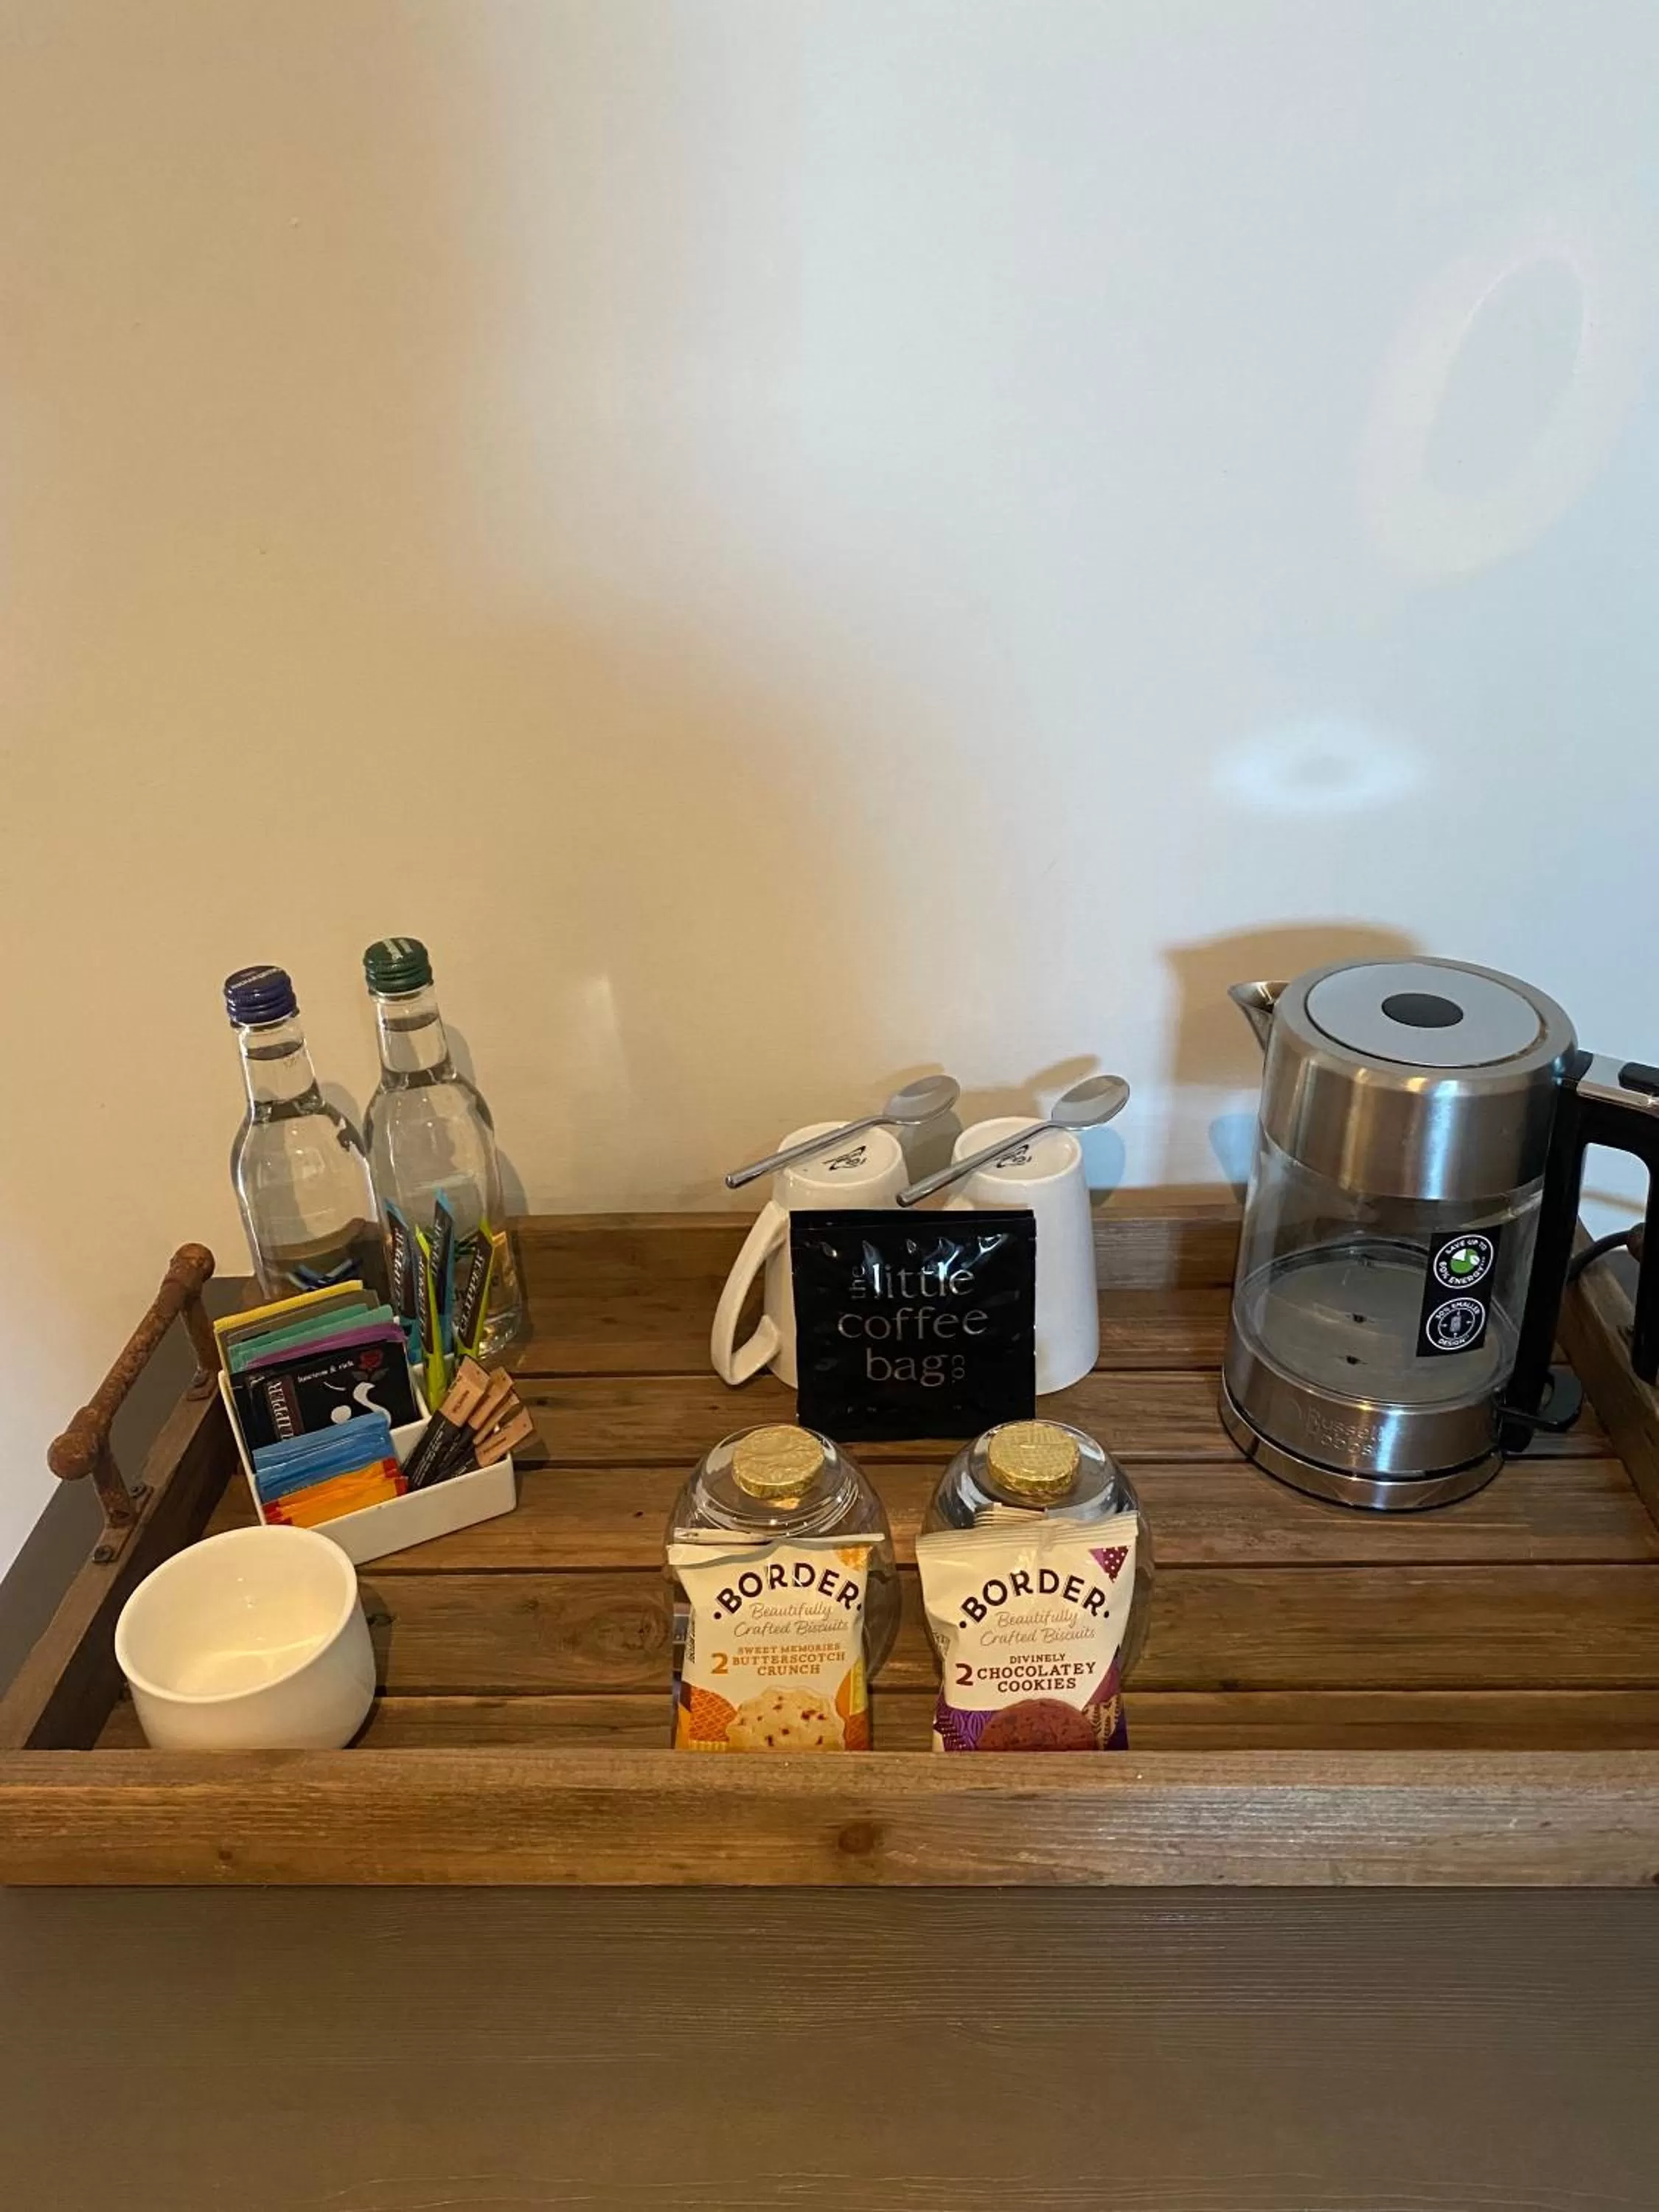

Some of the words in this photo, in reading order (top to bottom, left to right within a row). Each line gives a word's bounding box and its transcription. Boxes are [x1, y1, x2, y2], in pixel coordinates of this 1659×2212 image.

[1444, 1239, 1467, 1255] SAVE
[1466, 1238, 1479, 1247] UP
[1478, 1239, 1488, 1252] TO
[872, 1262, 975, 1300] little
[837, 1306, 990, 1341] coffee
[865, 1346, 950, 1387] bag
[268, 1381, 293, 1439] LIPPER
[748, 1601, 832, 1621] Beautifully
[995, 1609, 1079, 1629] Beautifully
[734, 1621, 790, 1638] Crafted
[795, 1618, 848, 1635] Biscuits
[980, 1629, 1037, 1646] Crafted
[1040, 1626, 1096, 1644] Biscuits
[738, 1645, 776, 1655] SWEET
[780, 1641, 841, 1654] MEMORIES
[710, 1652, 729, 1674] 2
[731, 1651, 846, 1666] BUTTERSCOTCH
[1009, 1653, 1066, 1665] DIVINELY
[757, 1663, 821, 1676] CRUNCH
[955, 1663, 974, 1687] 2
[976, 1661, 1097, 1680] CHOCOLATEY
[997, 1677, 1077, 1694] COOKIES
